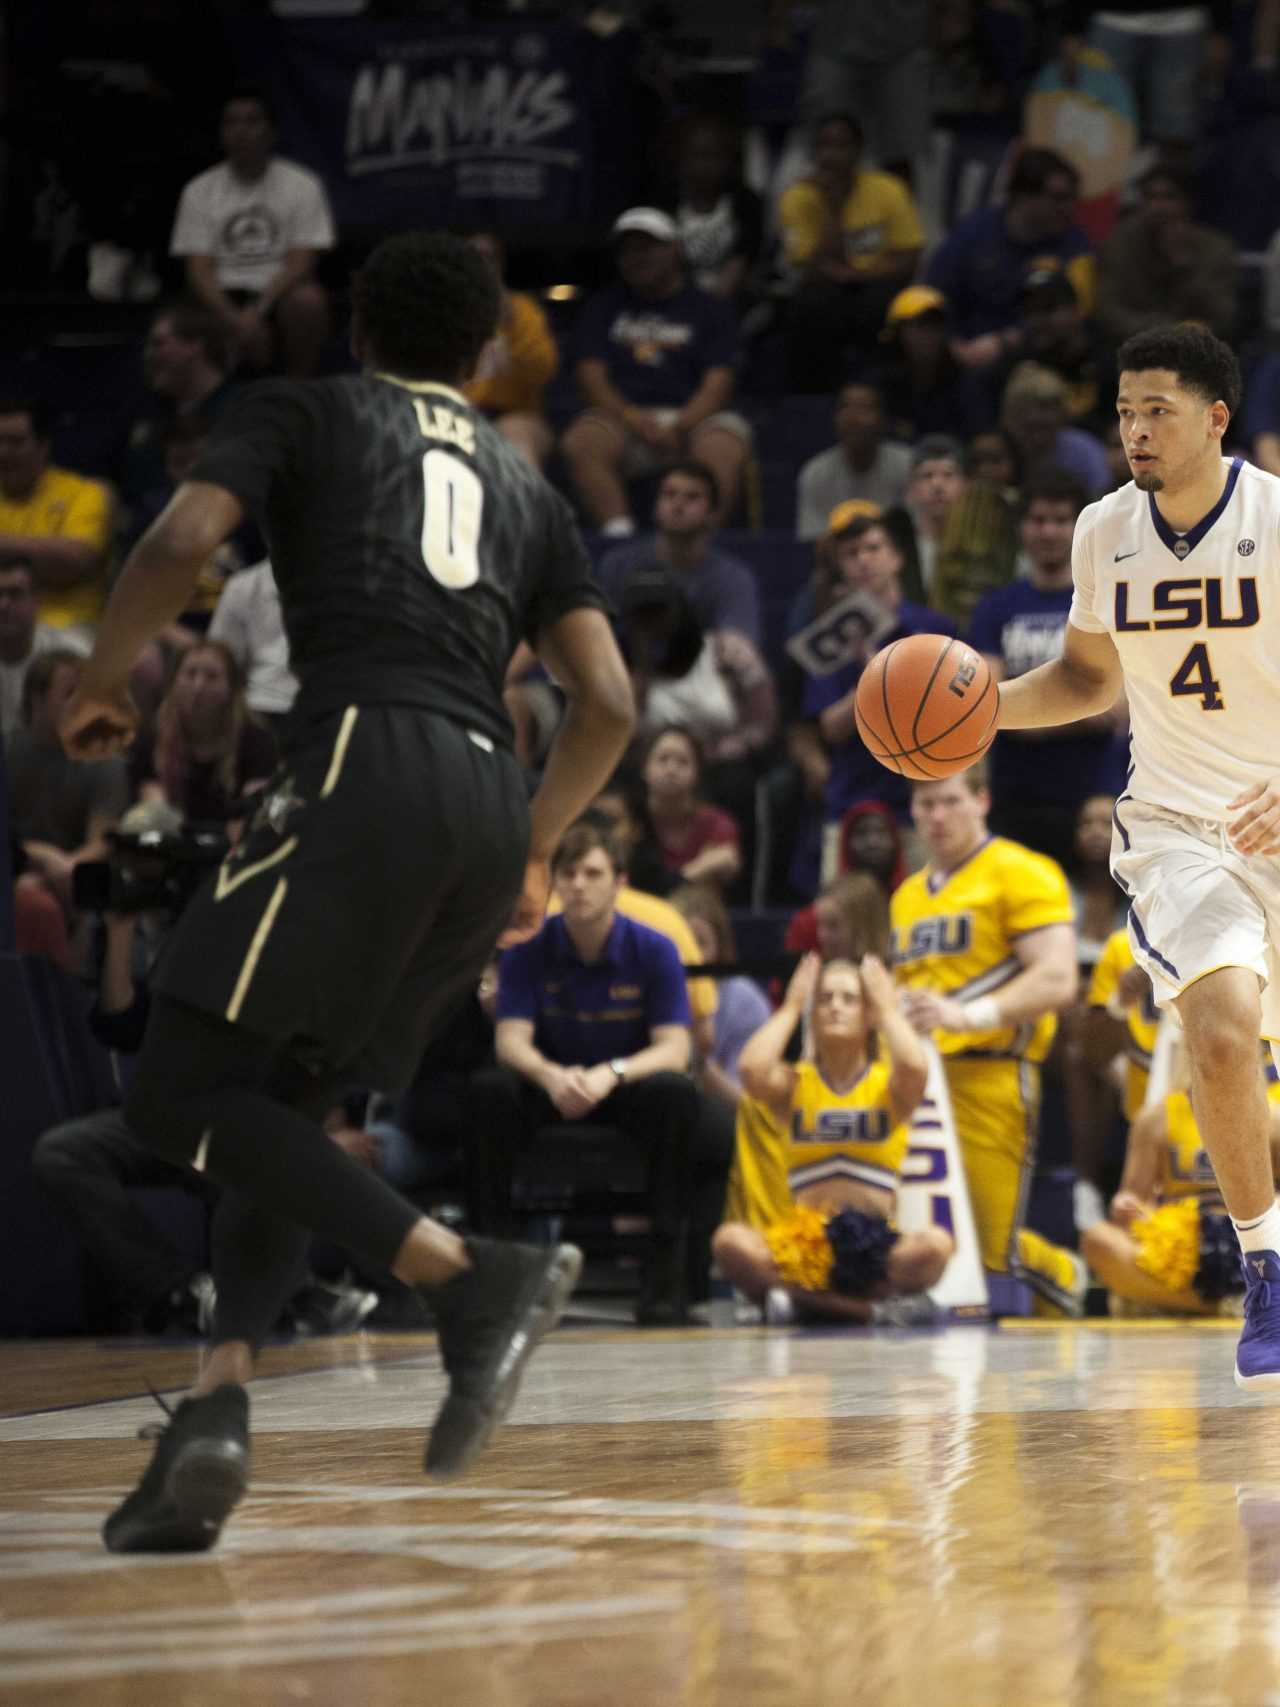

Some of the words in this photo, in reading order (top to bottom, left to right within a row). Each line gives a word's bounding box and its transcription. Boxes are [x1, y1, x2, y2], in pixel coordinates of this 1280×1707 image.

[413, 397, 476, 456] LEE
[421, 448, 484, 590] 0
[1114, 576, 1260, 632] LSU
[1170, 642, 1225, 711] 4
[791, 1107, 889, 1141] LSU
